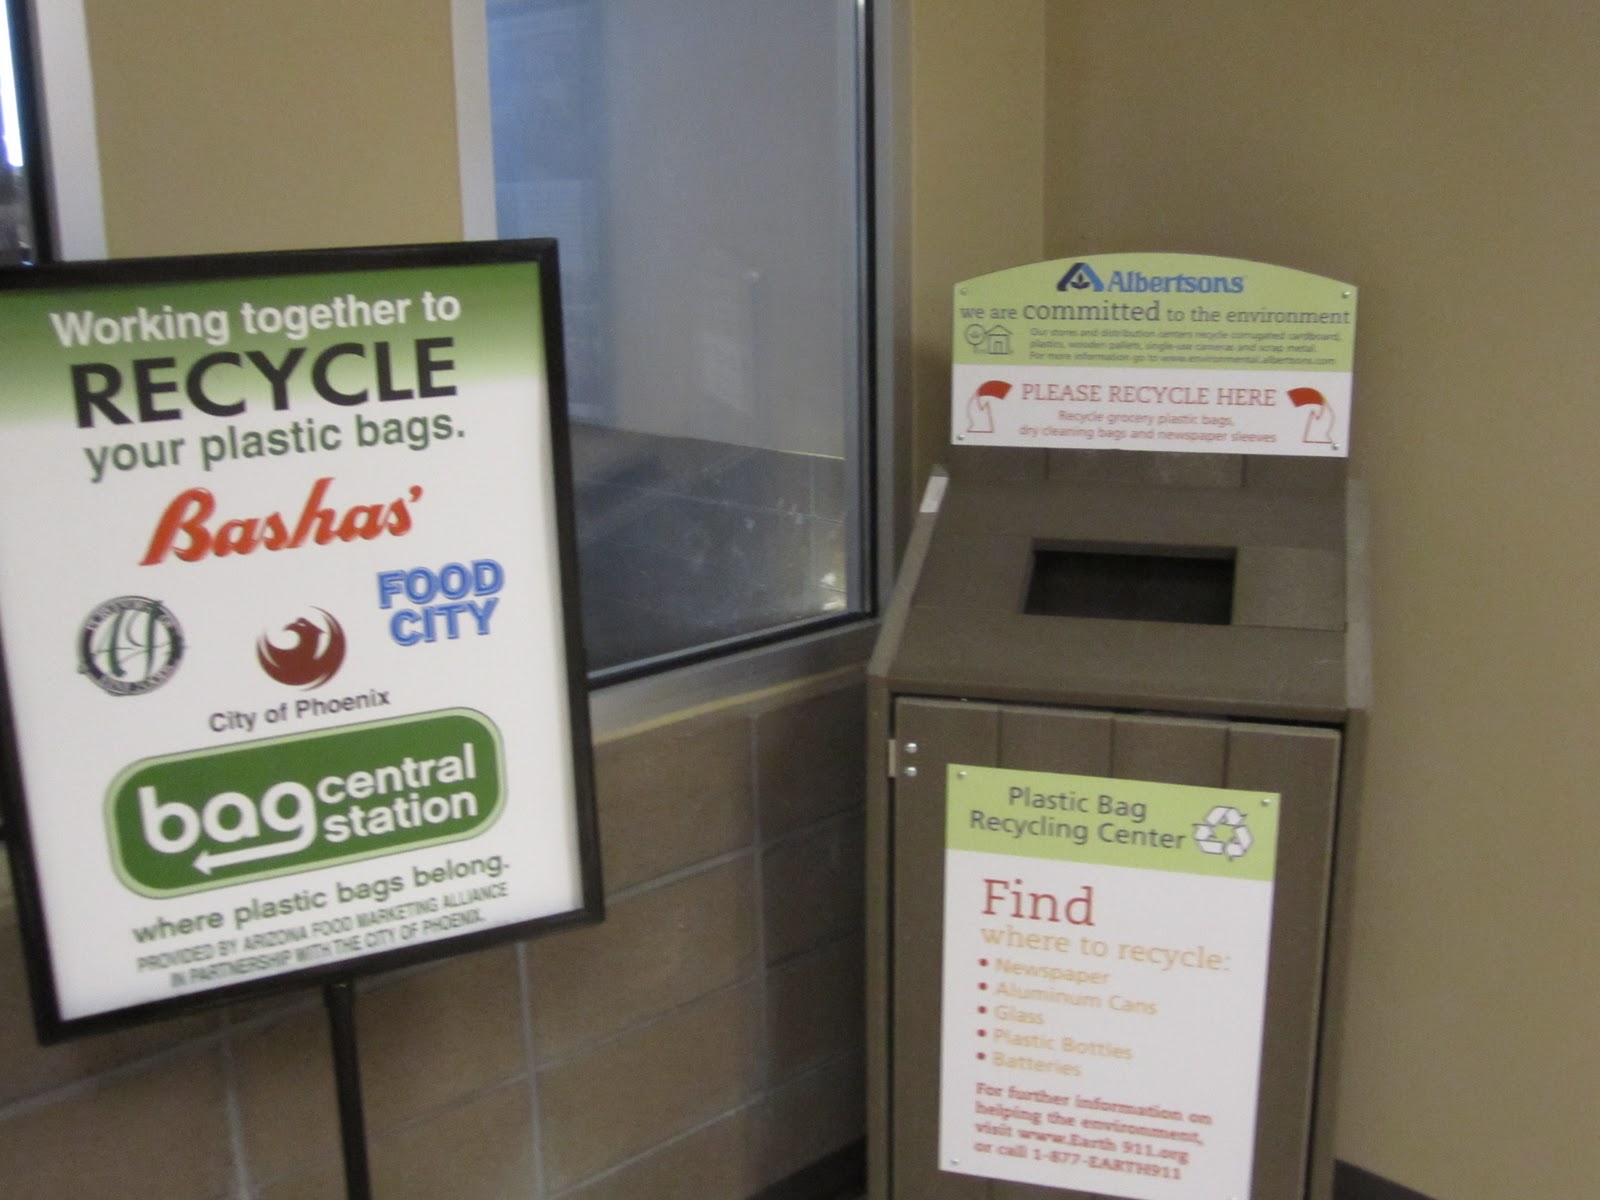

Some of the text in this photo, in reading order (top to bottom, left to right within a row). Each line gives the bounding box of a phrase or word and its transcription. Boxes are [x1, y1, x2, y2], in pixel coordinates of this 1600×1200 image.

[1107, 270, 1245, 293] Albertsons
[50, 292, 460, 347] Working together to
[959, 300, 1350, 324] we are committed to the environment
[70, 336, 458, 429] RECYCLE
[1021, 383, 1277, 406] PLEASE RECYCLE HERE
[1019, 425, 1277, 443] dry cleaning bags and newspaper sleeves
[1058, 410, 1104, 423] Recycle
[1107, 414, 1153, 425] grocery
[1157, 412, 1198, 425] plastic
[84, 411, 466, 483] your plastic bags.
[138, 477, 424, 566] Bashas'
[377, 559, 505, 609] FOOD
[390, 598, 499, 647] CITY
[208, 688, 391, 734] City of Phoenix
[315, 743, 476, 805] central
[138, 780, 318, 867] bag
[322, 788, 478, 843] station
[1007, 786, 1148, 824] Plastic Bag
[969, 810, 1186, 850] Recycling Center
[132, 855, 509, 943] where plastic bags belong.
[981, 878, 1096, 926] Find
[136, 882, 509, 971] PROVIDED BY ARIZONA FOOD MARKETING ALLIANCE
[171, 972, 187, 987] IN
[189, 950, 291, 980] PARTNERSHIP
[295, 942, 332, 962] WITH
[334, 935, 362, 951] THE
[364, 929, 395, 948] CITY
[401, 923, 418, 940] OF
[980, 925, 1231, 972] where to recycle:
[995, 957, 1111, 985] Newspaper
[993, 981, 1158, 1015] Aluminum Cans
[993, 1004, 1045, 1025] Glass
[992, 1050, 1083, 1077] Batteries
[993, 1028, 1133, 1060] Plastic Bottles
[975, 1101, 1042, 1125] helping
[1047, 1112, 1075, 1127] the
[976, 1082, 1212, 1125] For further information on
[974, 1121, 1012, 1137] visit
[974, 1142, 992, 1153] or
[996, 1144, 1027, 1158] call
